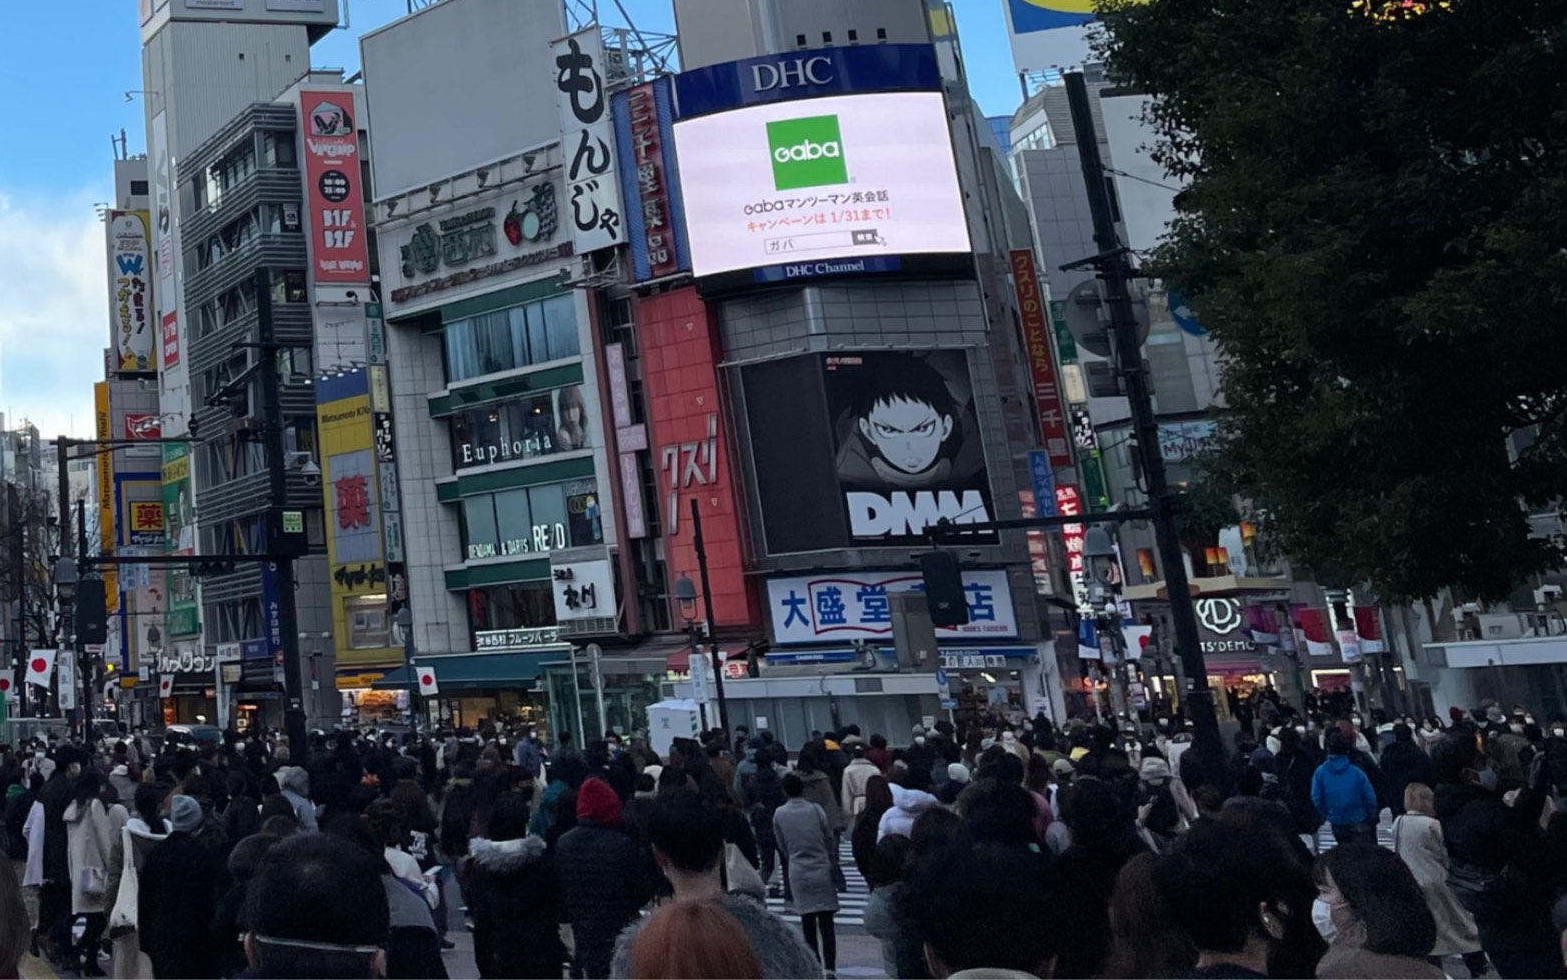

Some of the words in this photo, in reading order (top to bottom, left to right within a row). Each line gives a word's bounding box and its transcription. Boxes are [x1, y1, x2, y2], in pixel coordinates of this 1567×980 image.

[752, 56, 834, 94] DHC
[555, 37, 621, 242] もんじゃ
[786, 264, 814, 278] DHC
[815, 260, 865, 275] Channel
[462, 433, 552, 464] Euphoria
[661, 412, 718, 536] クスリ
[781, 583, 996, 629] 大盛堂店
